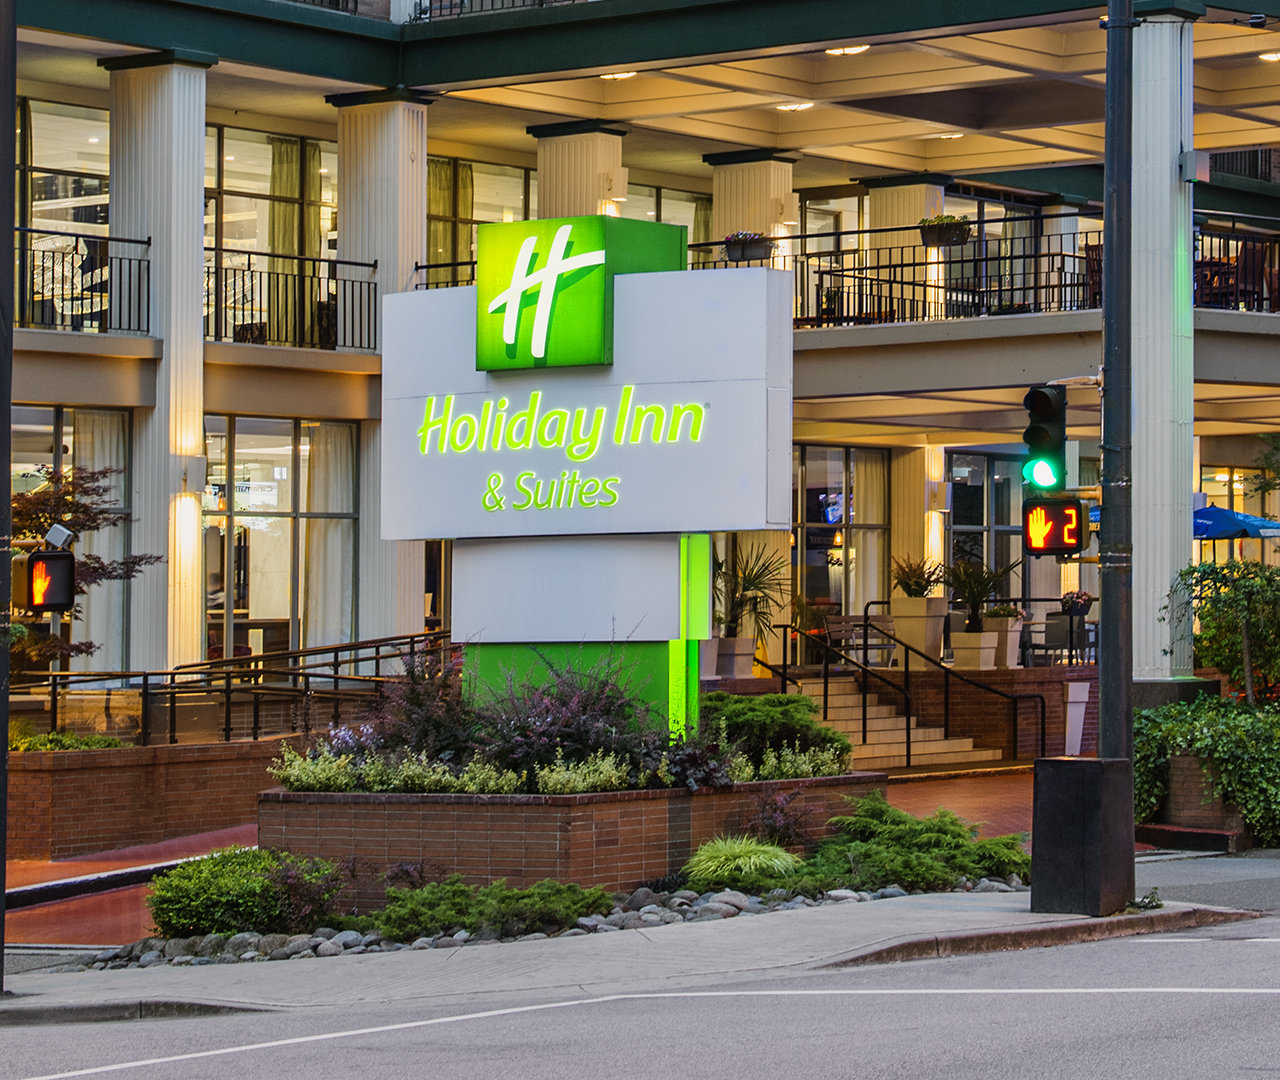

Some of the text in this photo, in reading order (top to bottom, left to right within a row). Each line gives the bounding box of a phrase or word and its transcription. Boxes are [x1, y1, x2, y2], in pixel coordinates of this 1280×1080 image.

[488, 224, 605, 359] H
[417, 385, 705, 462] Holiday Inn
[481, 470, 620, 512] & Suites
[1063, 508, 1077, 544] 2
